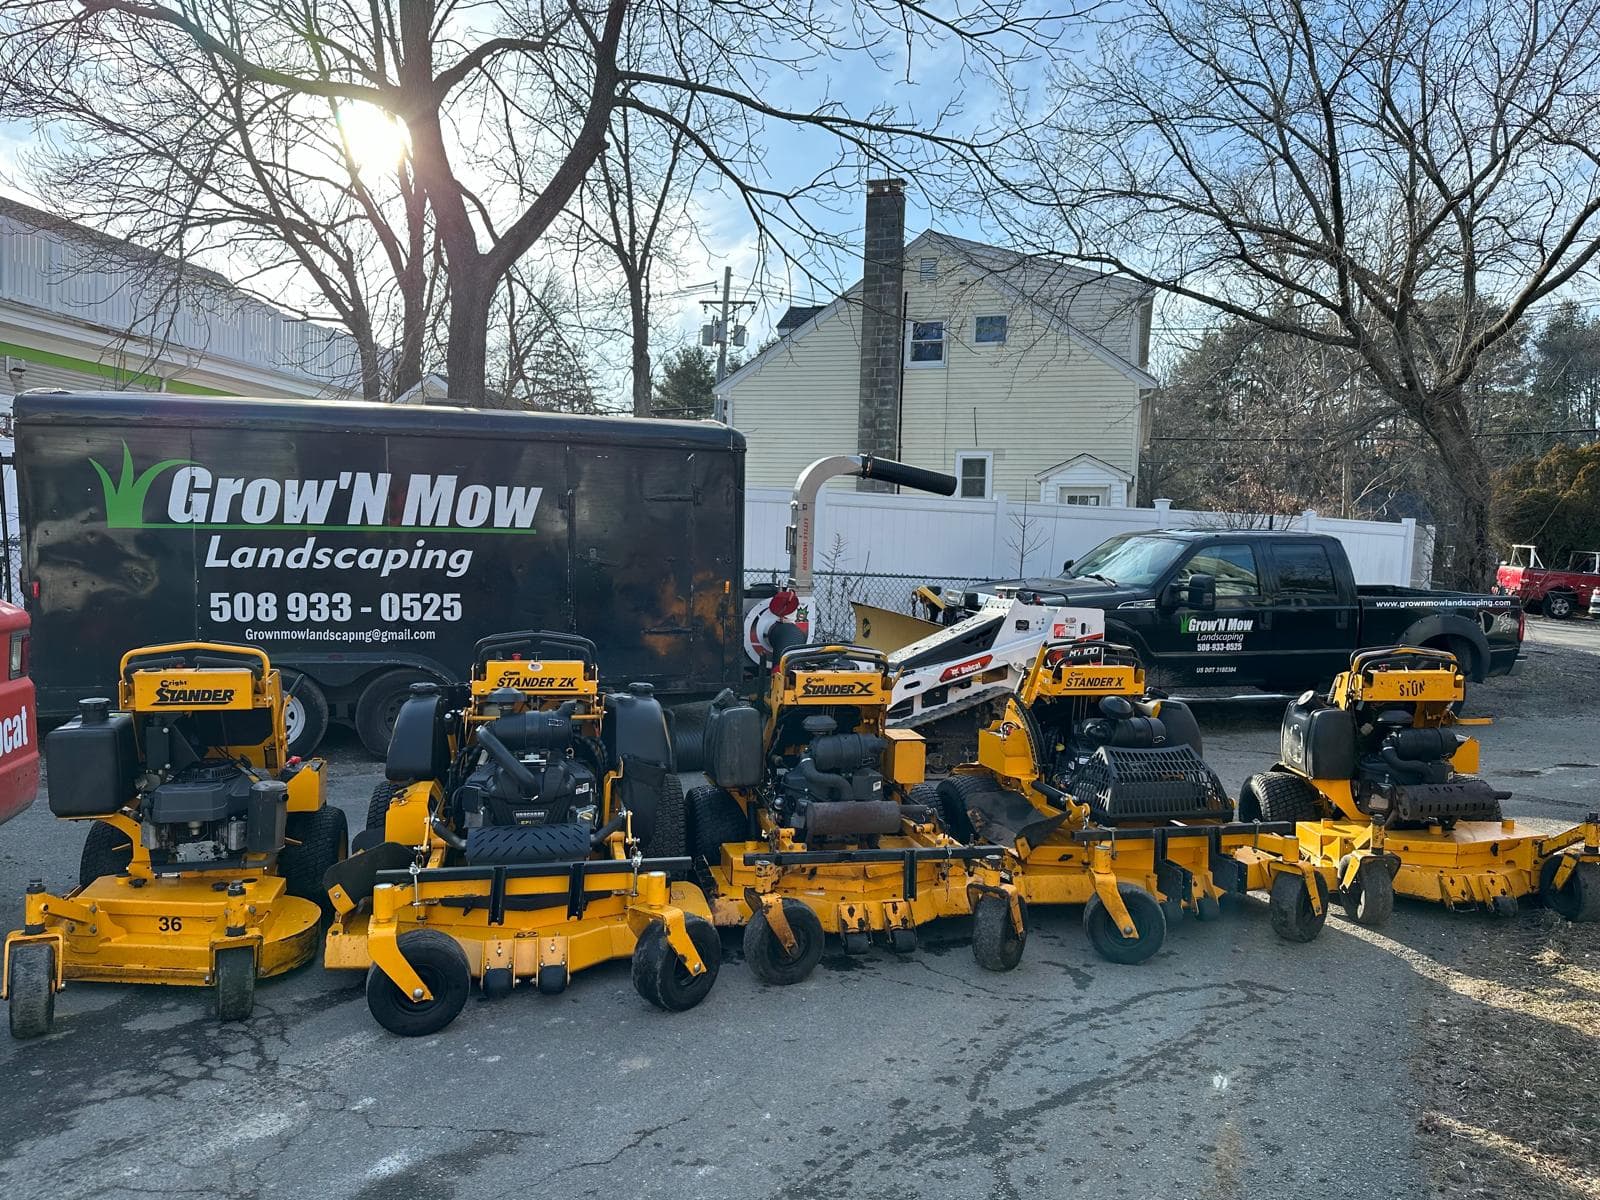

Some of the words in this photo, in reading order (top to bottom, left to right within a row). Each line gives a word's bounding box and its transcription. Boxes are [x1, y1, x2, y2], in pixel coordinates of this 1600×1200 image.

[401, 474, 543, 528] Mow
[205, 535, 473, 577] Landscaping
[210, 592, 278, 622] 508
[287, 592, 352, 622] 933
[380, 592, 462, 622] 0525
[1376, 598, 1511, 608] www.grownmowlandscaping.com
[1227, 618, 1254, 631] Mow
[245, 628, 436, 643] Grownmowlandscaping@gmail.com
[1196, 632, 1244, 642] Landscaping
[1197, 643, 1242, 652] 508-933-0525
[497, 677, 556, 687] STANDER
[557, 677, 577, 687] ZK
[802, 684, 856, 695] STANDER
[854, 681, 874, 694] X
[1065, 677, 1115, 687] STANDER
[1115, 677, 1125, 687] X
[155, 688, 235, 702] STANDER
[0, 705, 28, 757] cat
[158, 916, 182, 931] 36
